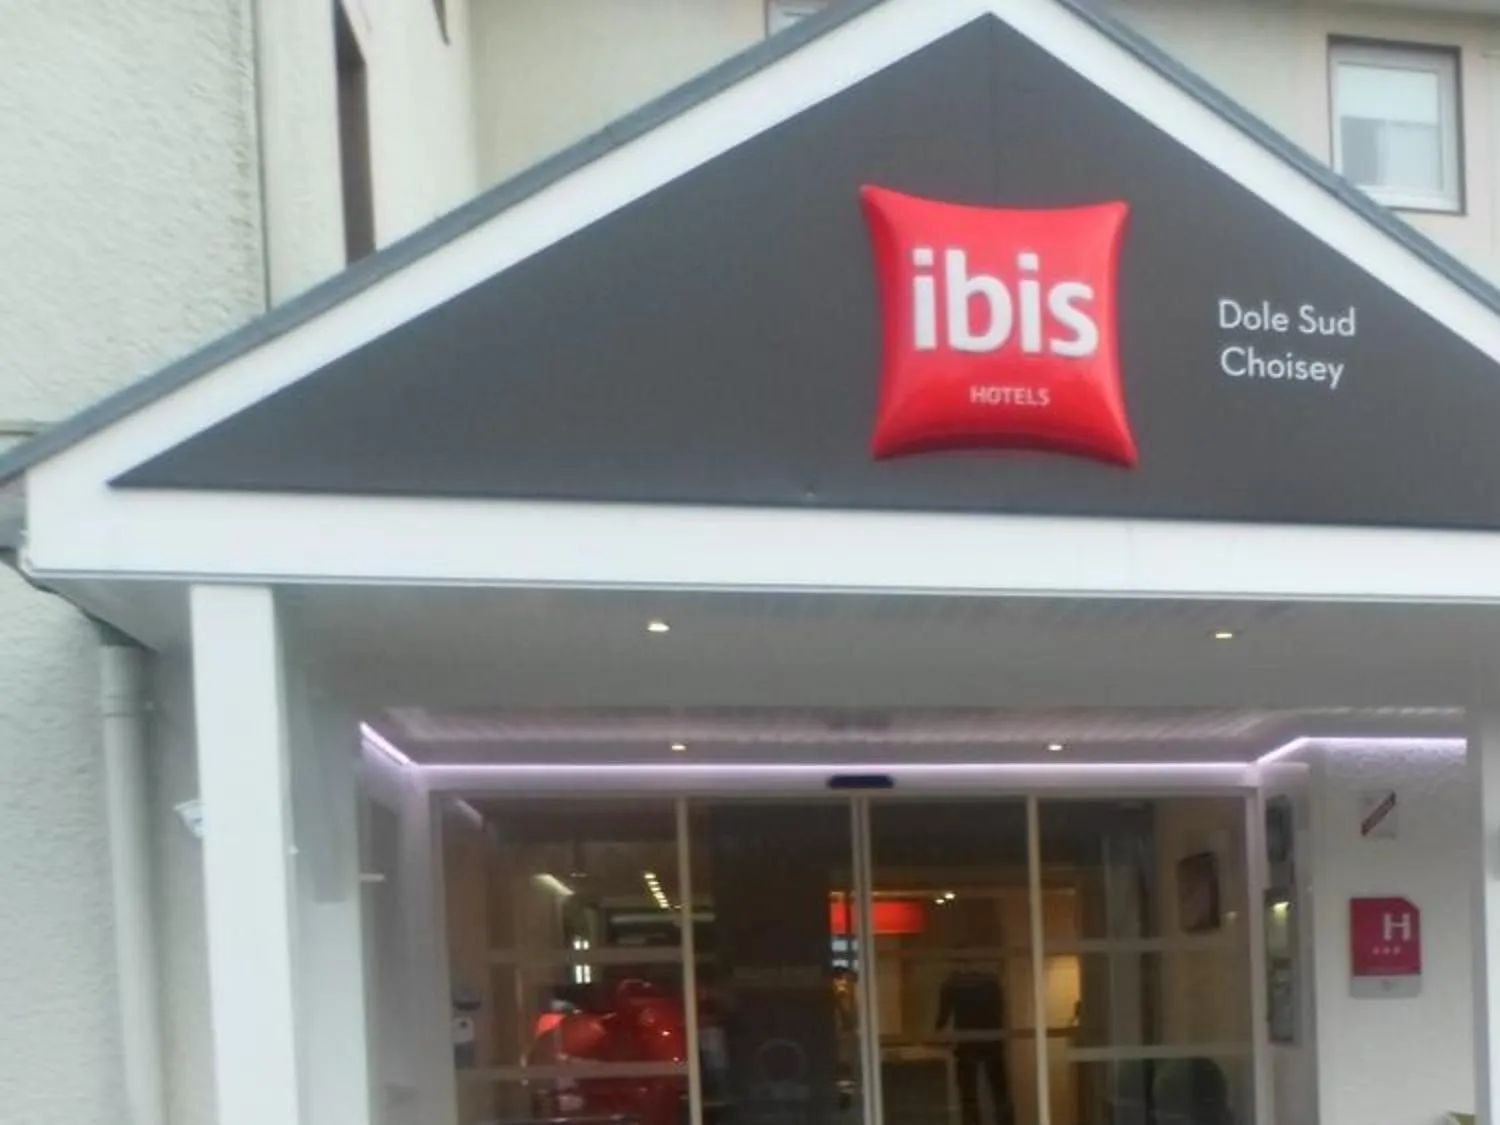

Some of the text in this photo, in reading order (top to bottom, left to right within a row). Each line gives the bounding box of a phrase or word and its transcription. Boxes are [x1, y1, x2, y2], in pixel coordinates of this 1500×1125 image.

[912, 247, 1099, 358] ibis
[1218, 299, 1356, 337] Dole Sud
[1220, 346, 1345, 390] Choisey
[969, 385, 1051, 406] HOTELS
[1382, 912, 1412, 942] H
